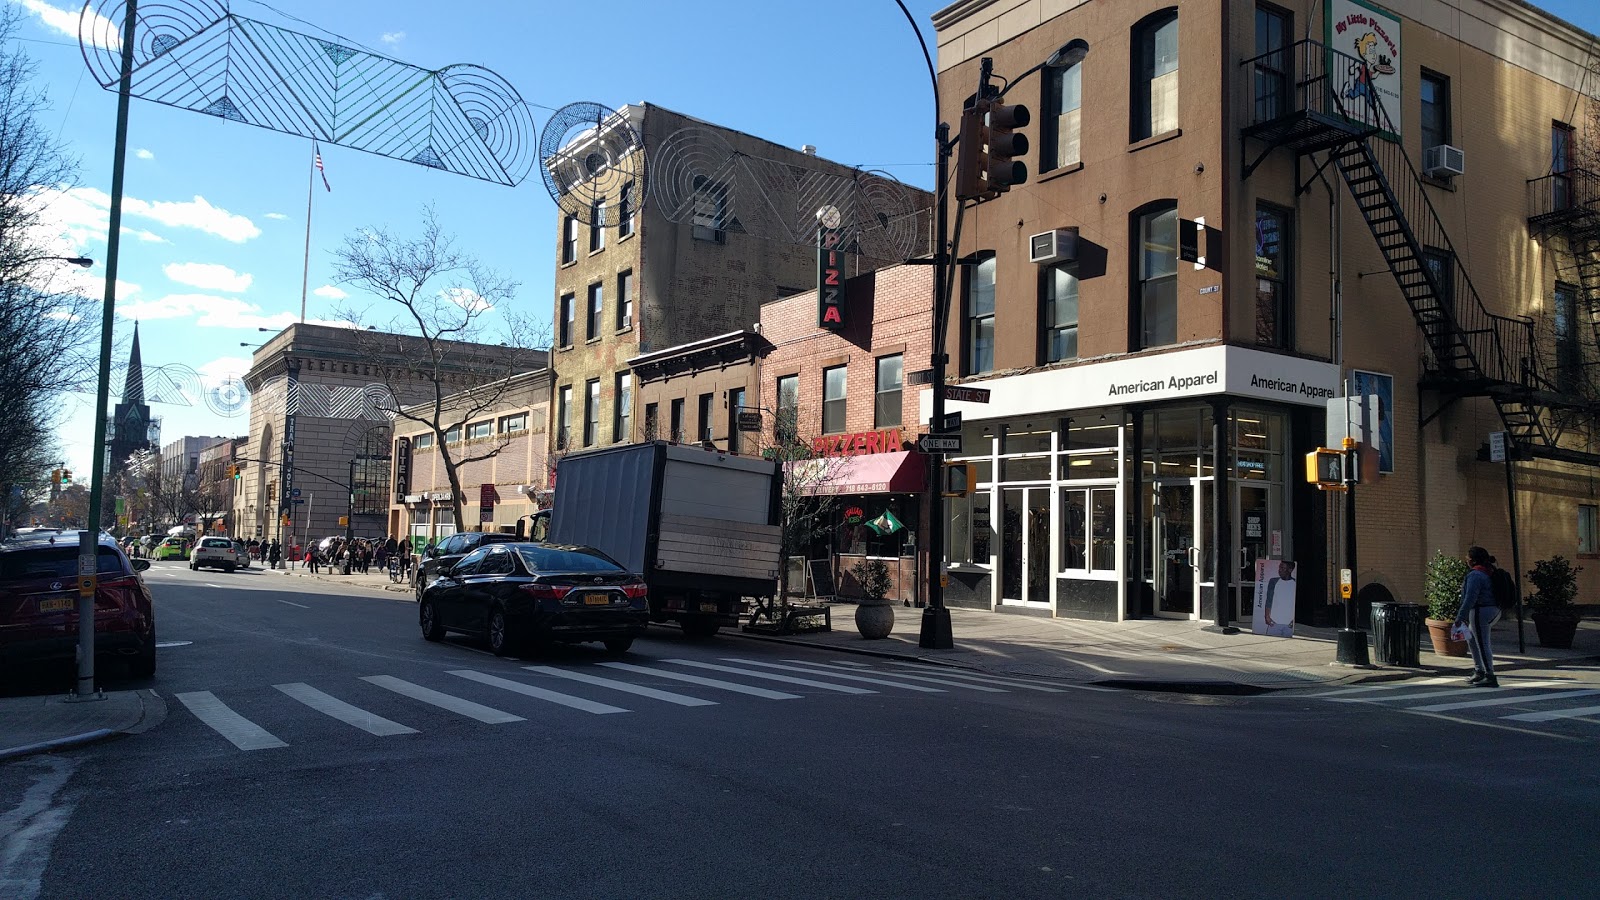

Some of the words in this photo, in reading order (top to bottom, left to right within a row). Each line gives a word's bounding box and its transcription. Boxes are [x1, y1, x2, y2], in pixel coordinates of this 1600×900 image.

[1335, 20, 1347, 35] My
[1346, 13, 1368, 25] Little
[1369, 17, 1398, 58] Pizzeria
[823, 232, 842, 323] PIZZA
[946, 388, 972, 400] STATE
[975, 391, 988, 402] ST
[1109, 379, 1164, 396] American
[1168, 371, 1217, 390] Apparel
[1251, 374, 1297, 393] American
[1300, 382, 1335, 399] Apparel
[813, 429, 901, 457] PIZZERIA
[923, 440, 939, 448] ONE
[943, 440, 956, 448] WAY
[399, 440, 407, 474] RITE
[397, 476, 406, 501] AID
[845, 484, 855, 492] 718
[857, 482, 886, 491] 643-6120
[1246, 523, 1261, 531] MEN'S
[1247, 516, 1260, 524] SHOP
